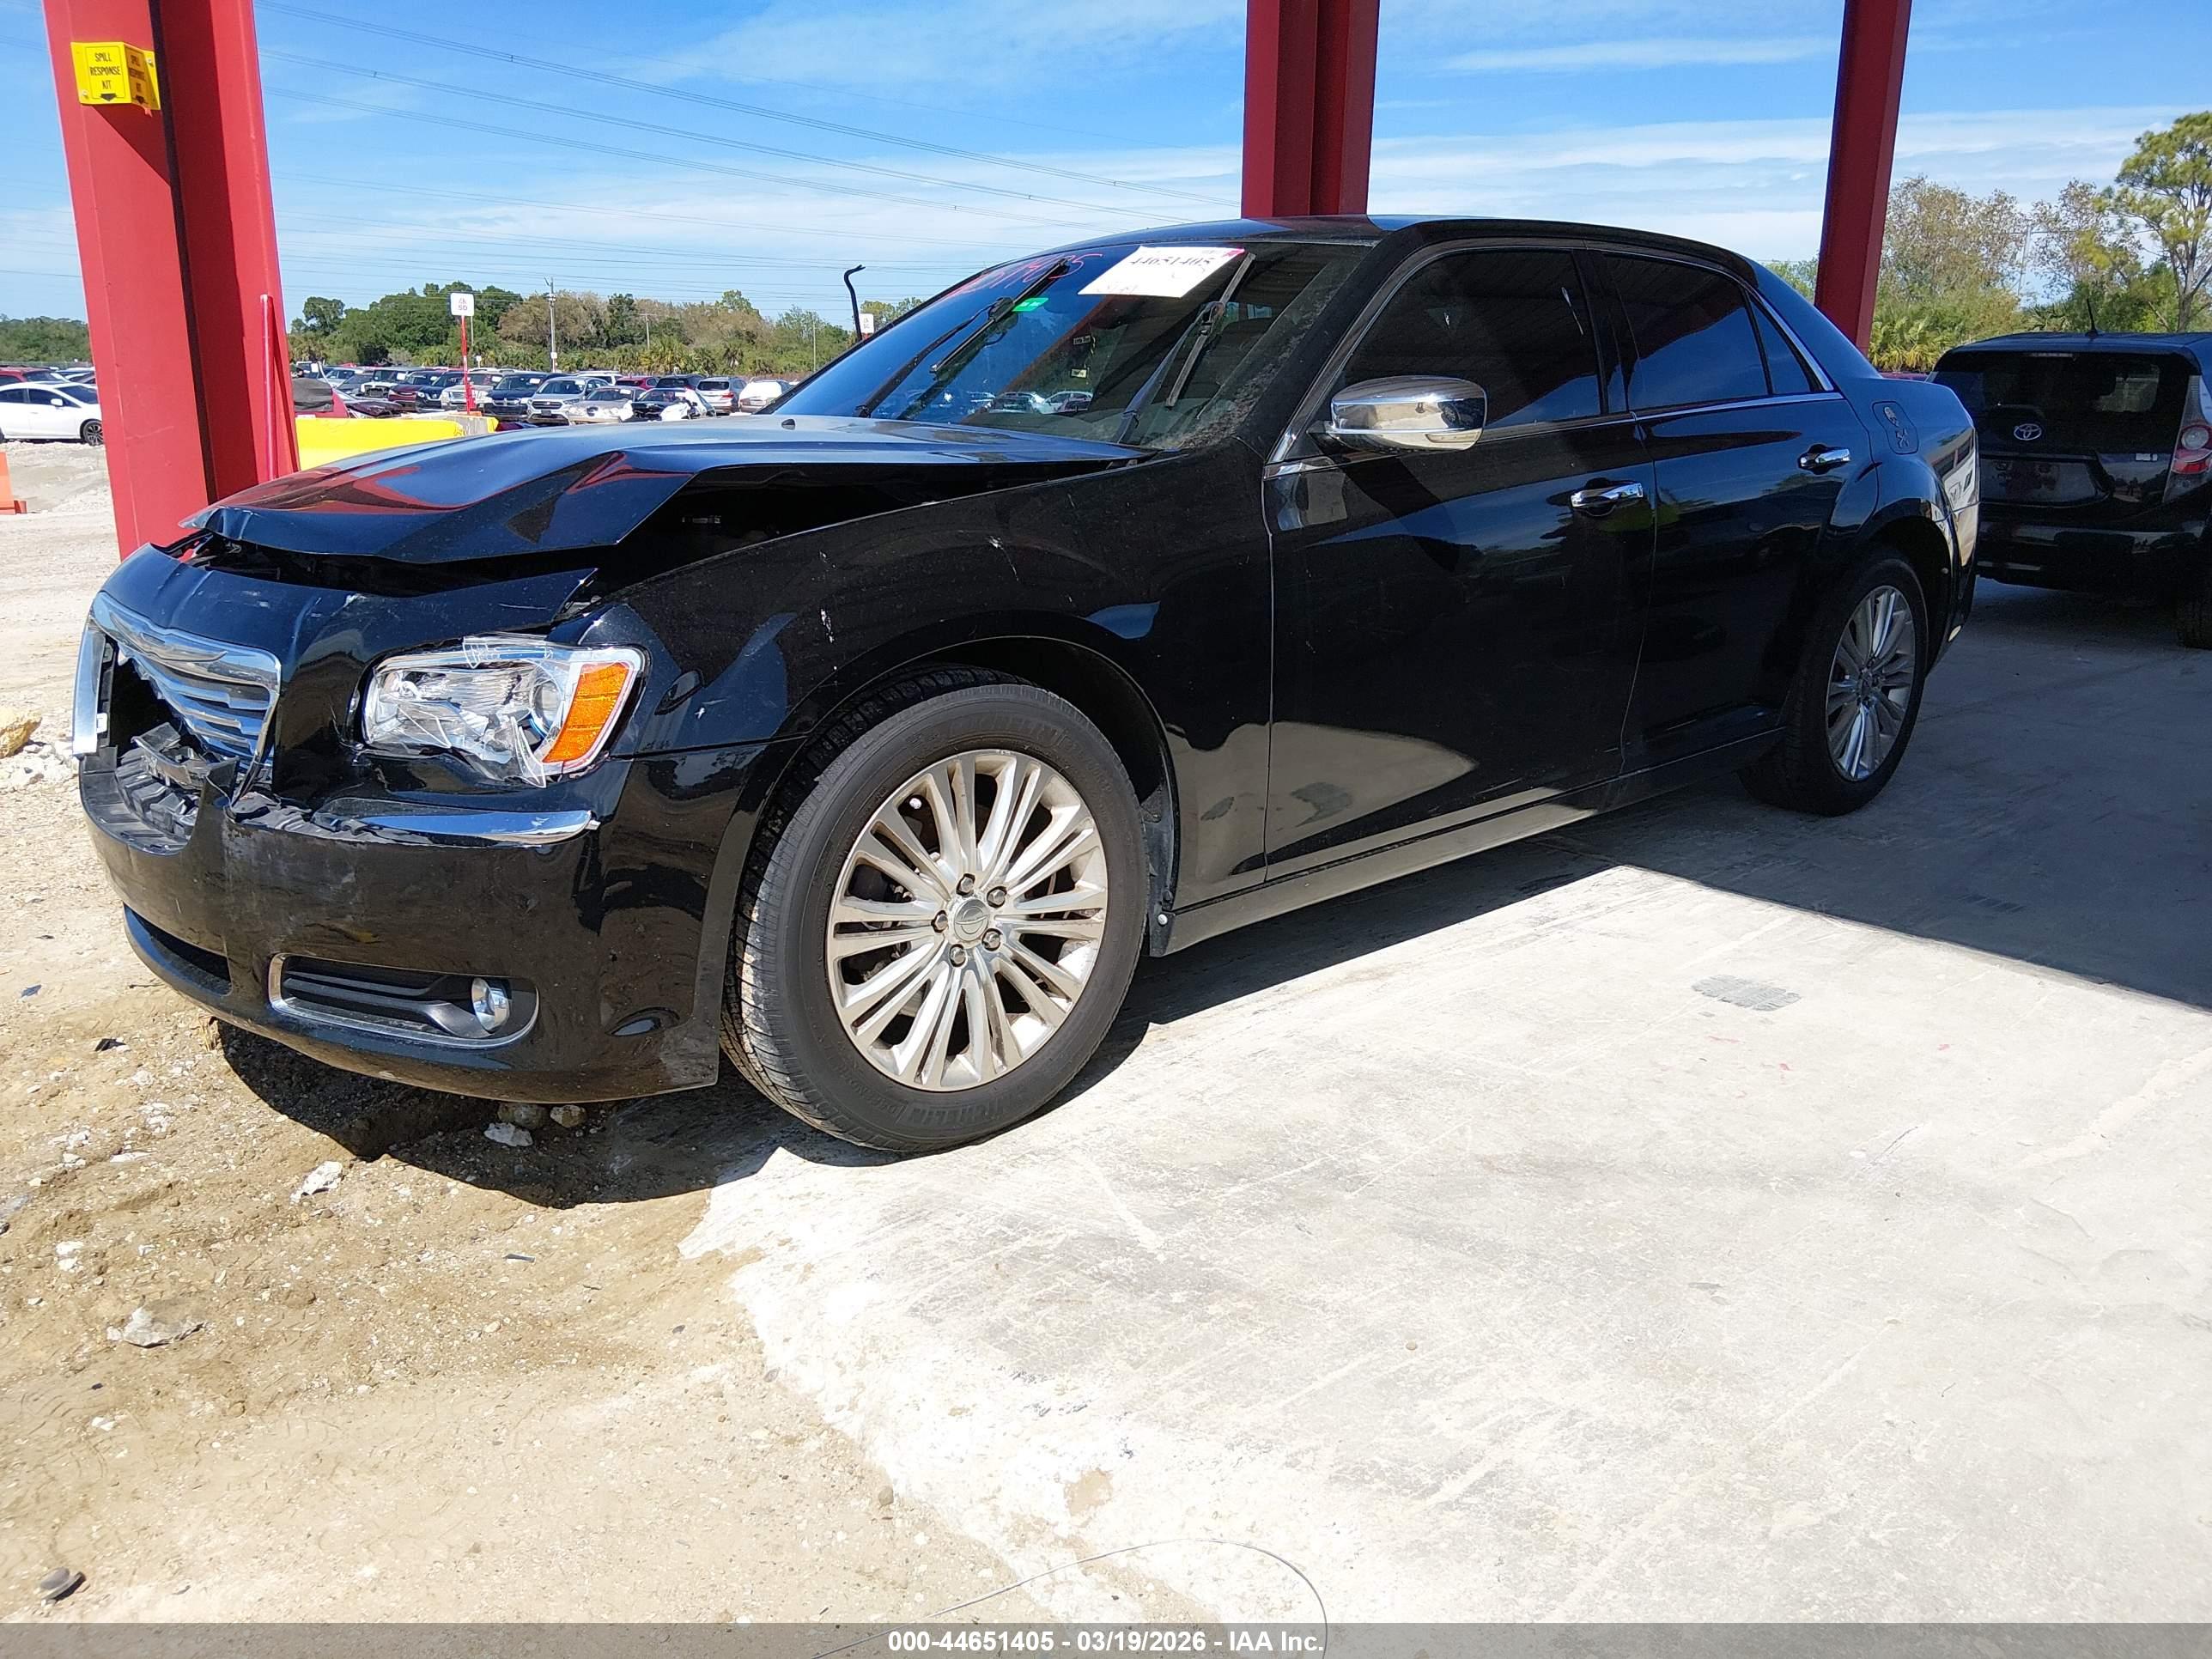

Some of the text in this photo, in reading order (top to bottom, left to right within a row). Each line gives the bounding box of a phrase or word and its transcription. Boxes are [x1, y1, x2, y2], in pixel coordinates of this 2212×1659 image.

[94, 52, 112, 62] SPILL
[89, 66, 121, 76] RESPONSE
[102, 80, 112, 90] KIT
